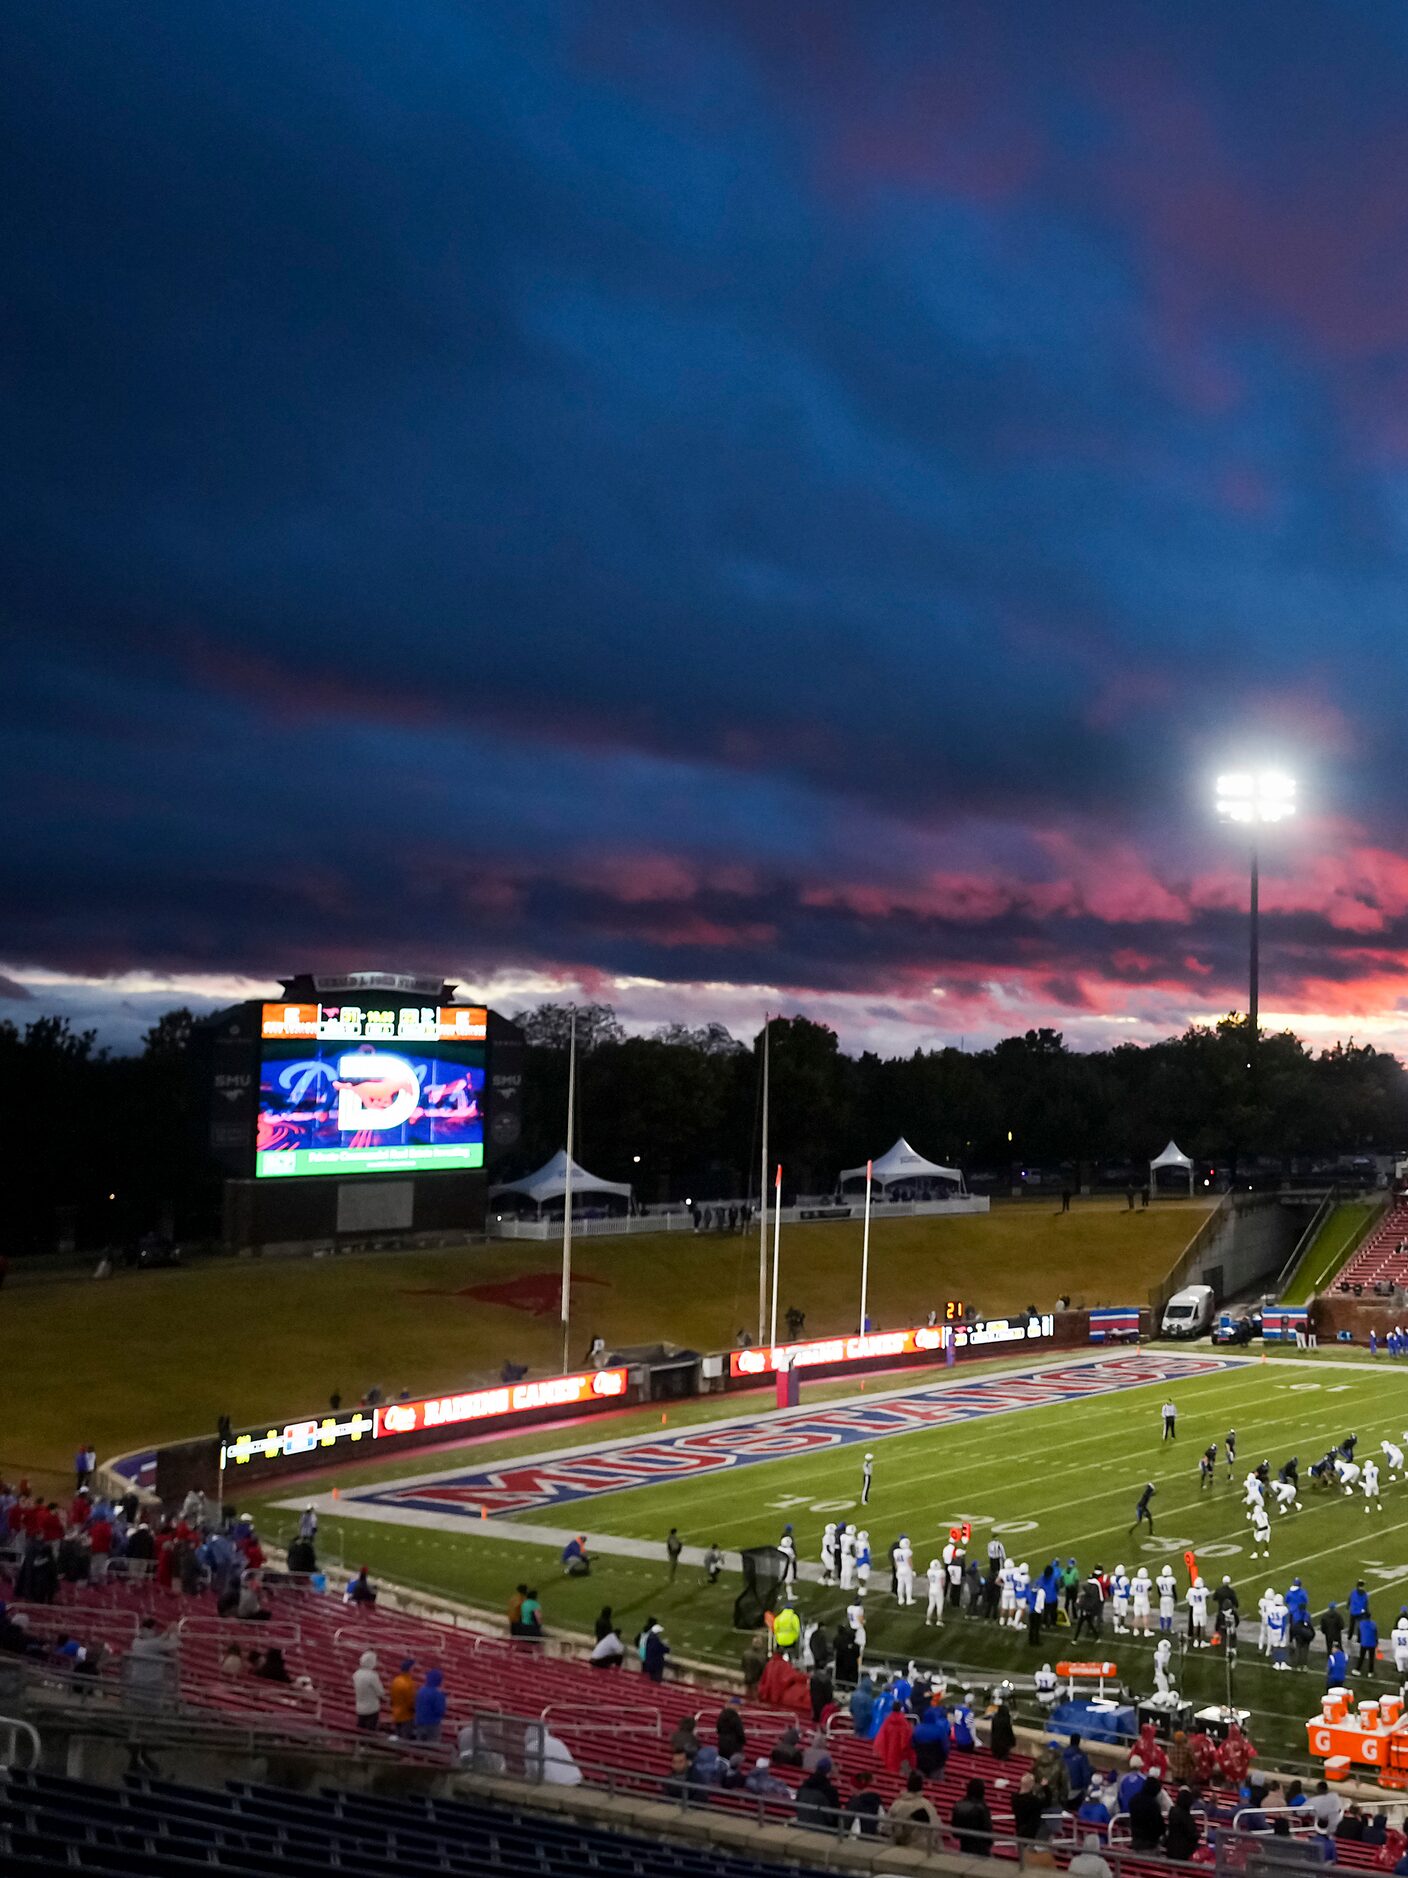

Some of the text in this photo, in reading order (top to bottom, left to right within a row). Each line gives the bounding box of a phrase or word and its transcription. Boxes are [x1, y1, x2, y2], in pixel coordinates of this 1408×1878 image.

[214, 1073, 251, 1087] SMU
[492, 1074, 522, 1086] SMU
[946, 1302, 962, 1319] 21
[393, 1356, 1228, 1514] MUSTANGS
[1315, 1730, 1331, 1752] G
[1362, 1739, 1378, 1760] G
